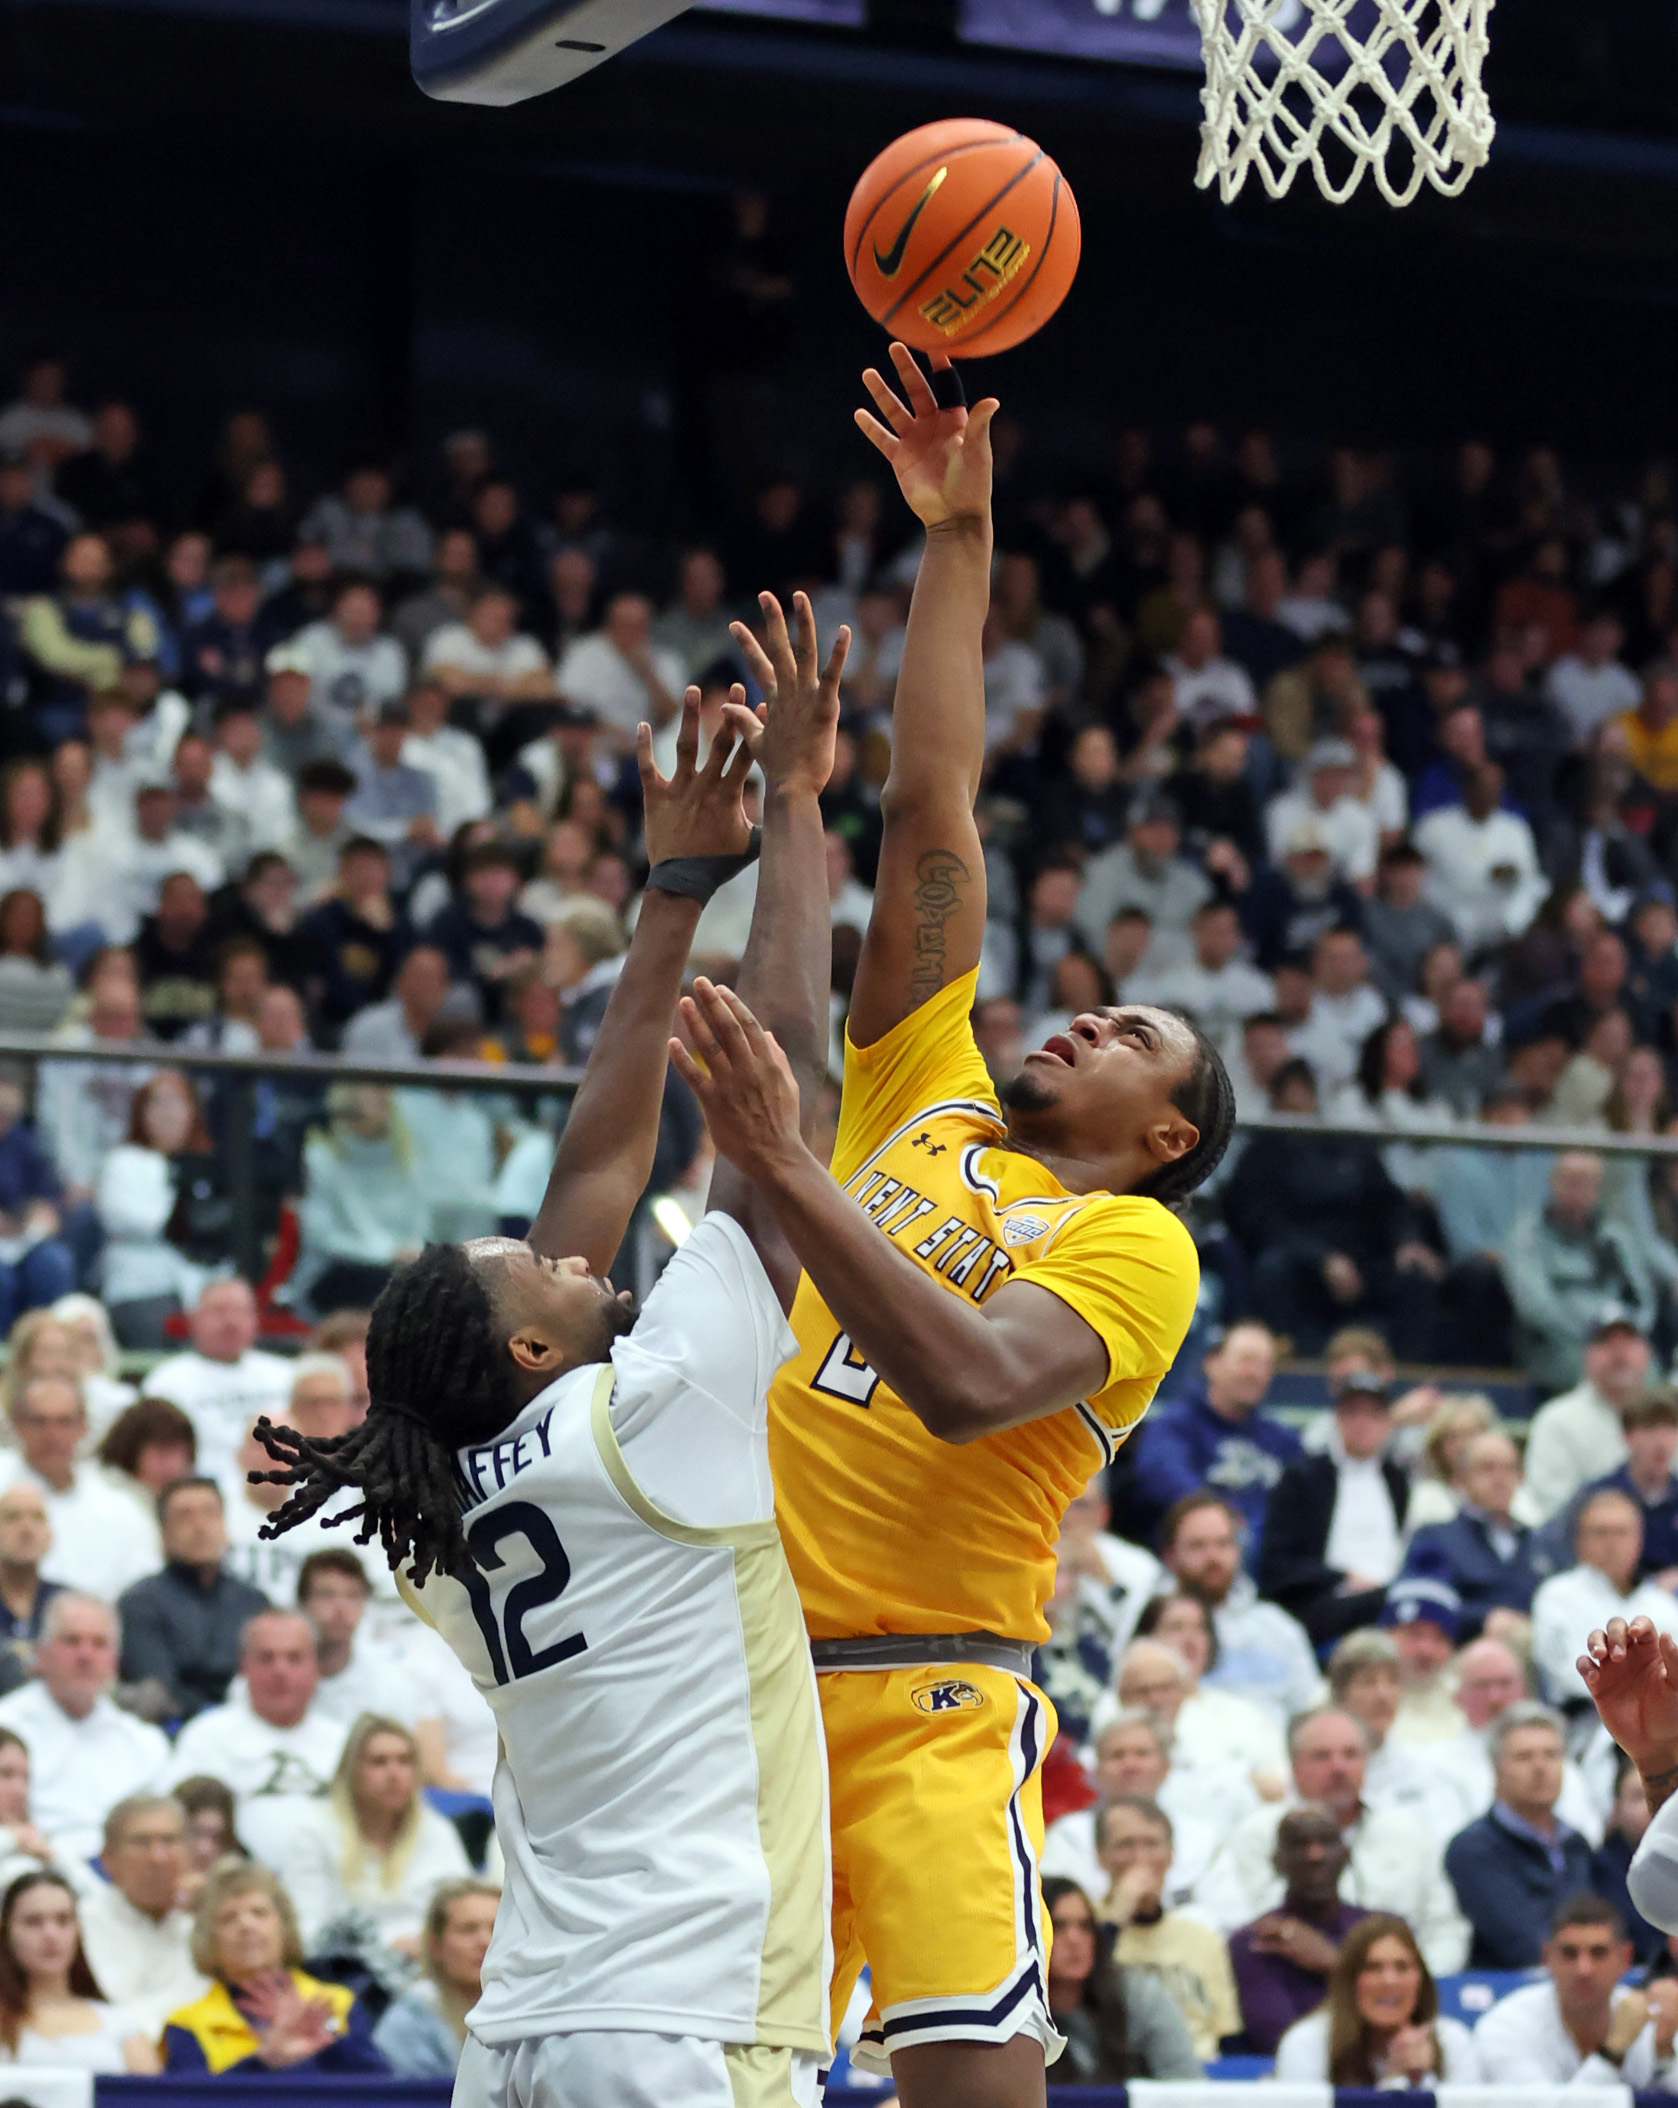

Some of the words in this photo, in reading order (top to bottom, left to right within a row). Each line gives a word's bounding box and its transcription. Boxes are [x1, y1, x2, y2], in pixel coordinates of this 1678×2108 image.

[920, 225, 1024, 329] ELITE
[852, 1170, 938, 1236] KENT
[913, 1216, 1015, 1303] STAT
[454, 1405, 555, 1513] AFFEY
[453, 1500, 589, 1687] 12
[929, 1684, 961, 1711] K
